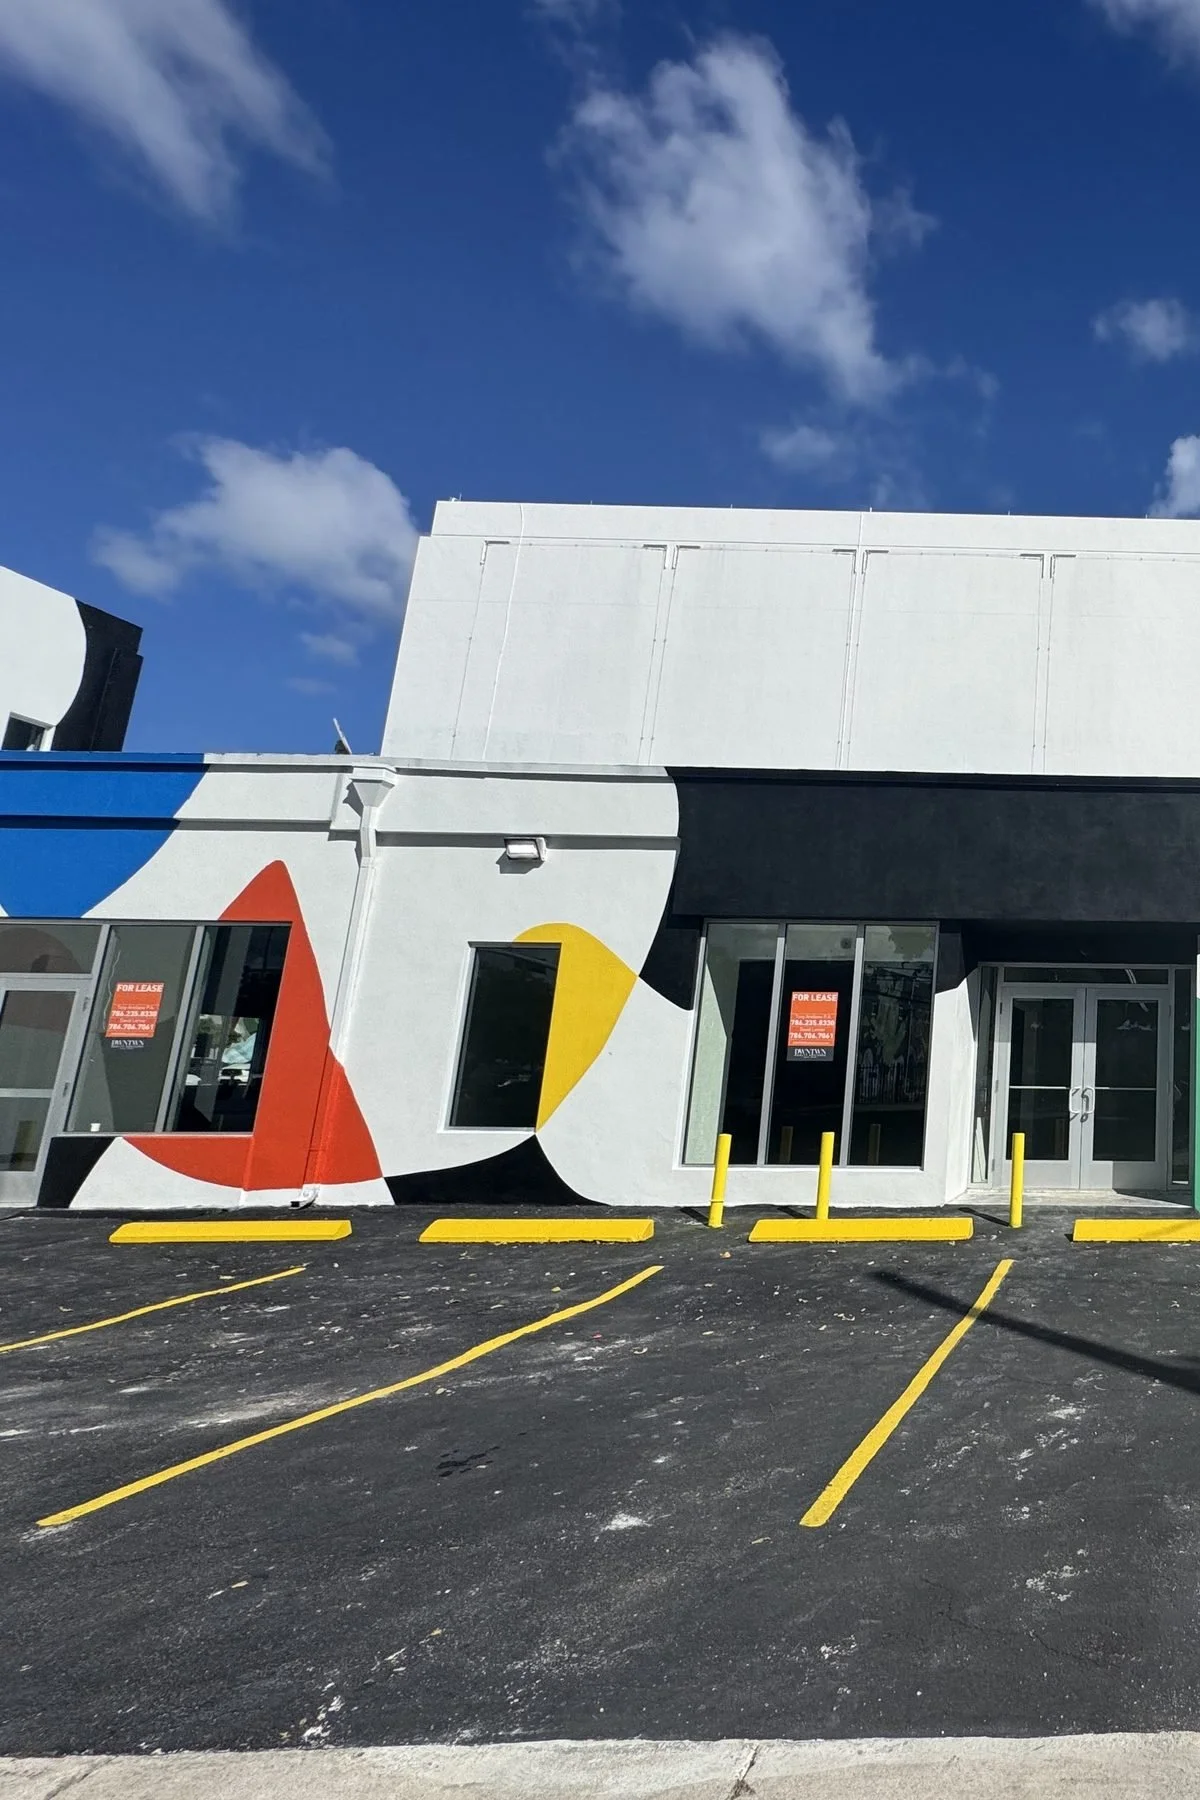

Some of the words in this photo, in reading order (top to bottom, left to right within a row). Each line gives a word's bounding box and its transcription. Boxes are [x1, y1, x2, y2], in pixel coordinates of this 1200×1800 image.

[116, 984, 134, 992] FOR
[135, 984, 163, 992] LEASE
[792, 993, 809, 1001] FOR
[811, 993, 838, 1001] LEASE
